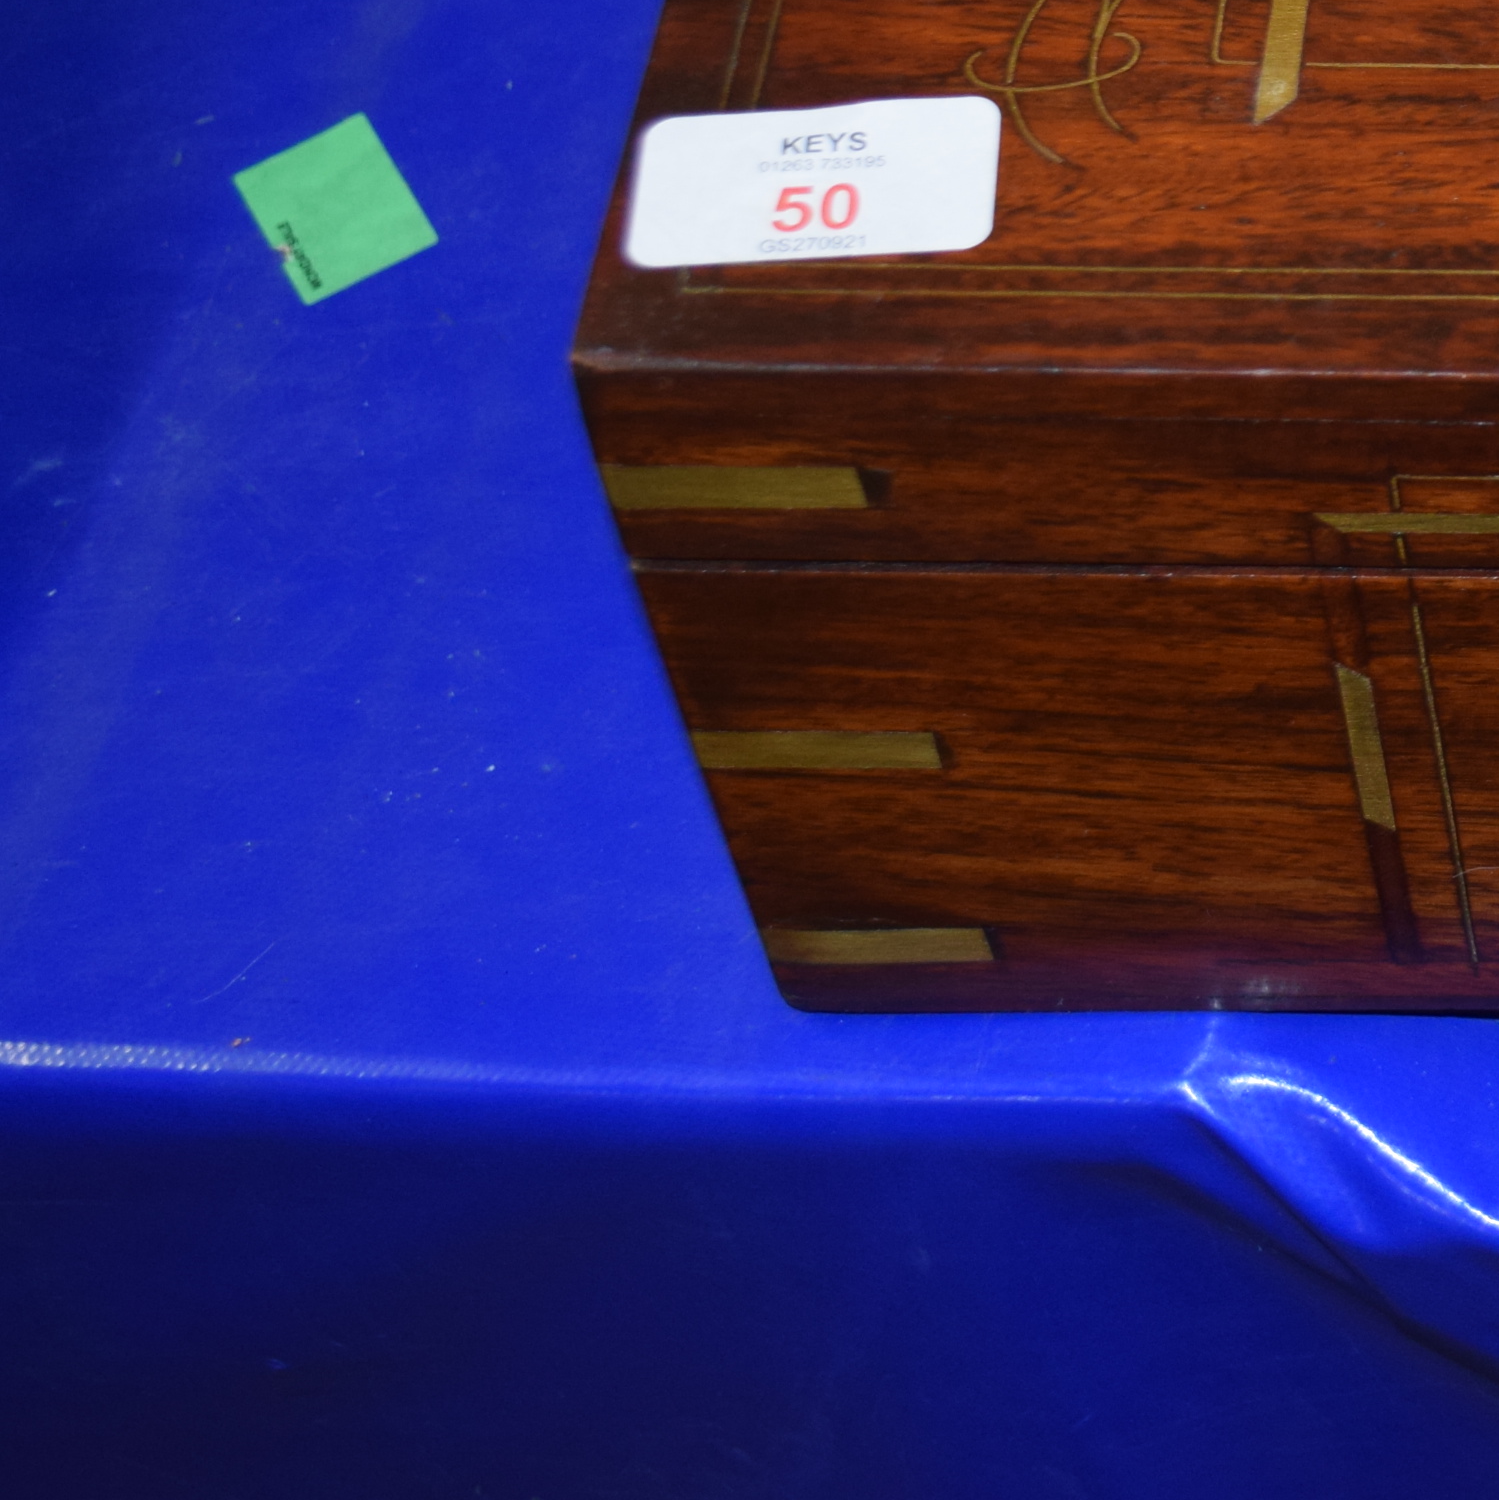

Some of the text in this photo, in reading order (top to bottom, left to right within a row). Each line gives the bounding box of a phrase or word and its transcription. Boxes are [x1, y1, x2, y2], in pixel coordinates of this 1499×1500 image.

[781, 131, 868, 156] KEYS
[759, 154, 886, 173] 01263 733195
[772, 182, 861, 232] 50
[758, 235, 867, 254] GS270921
